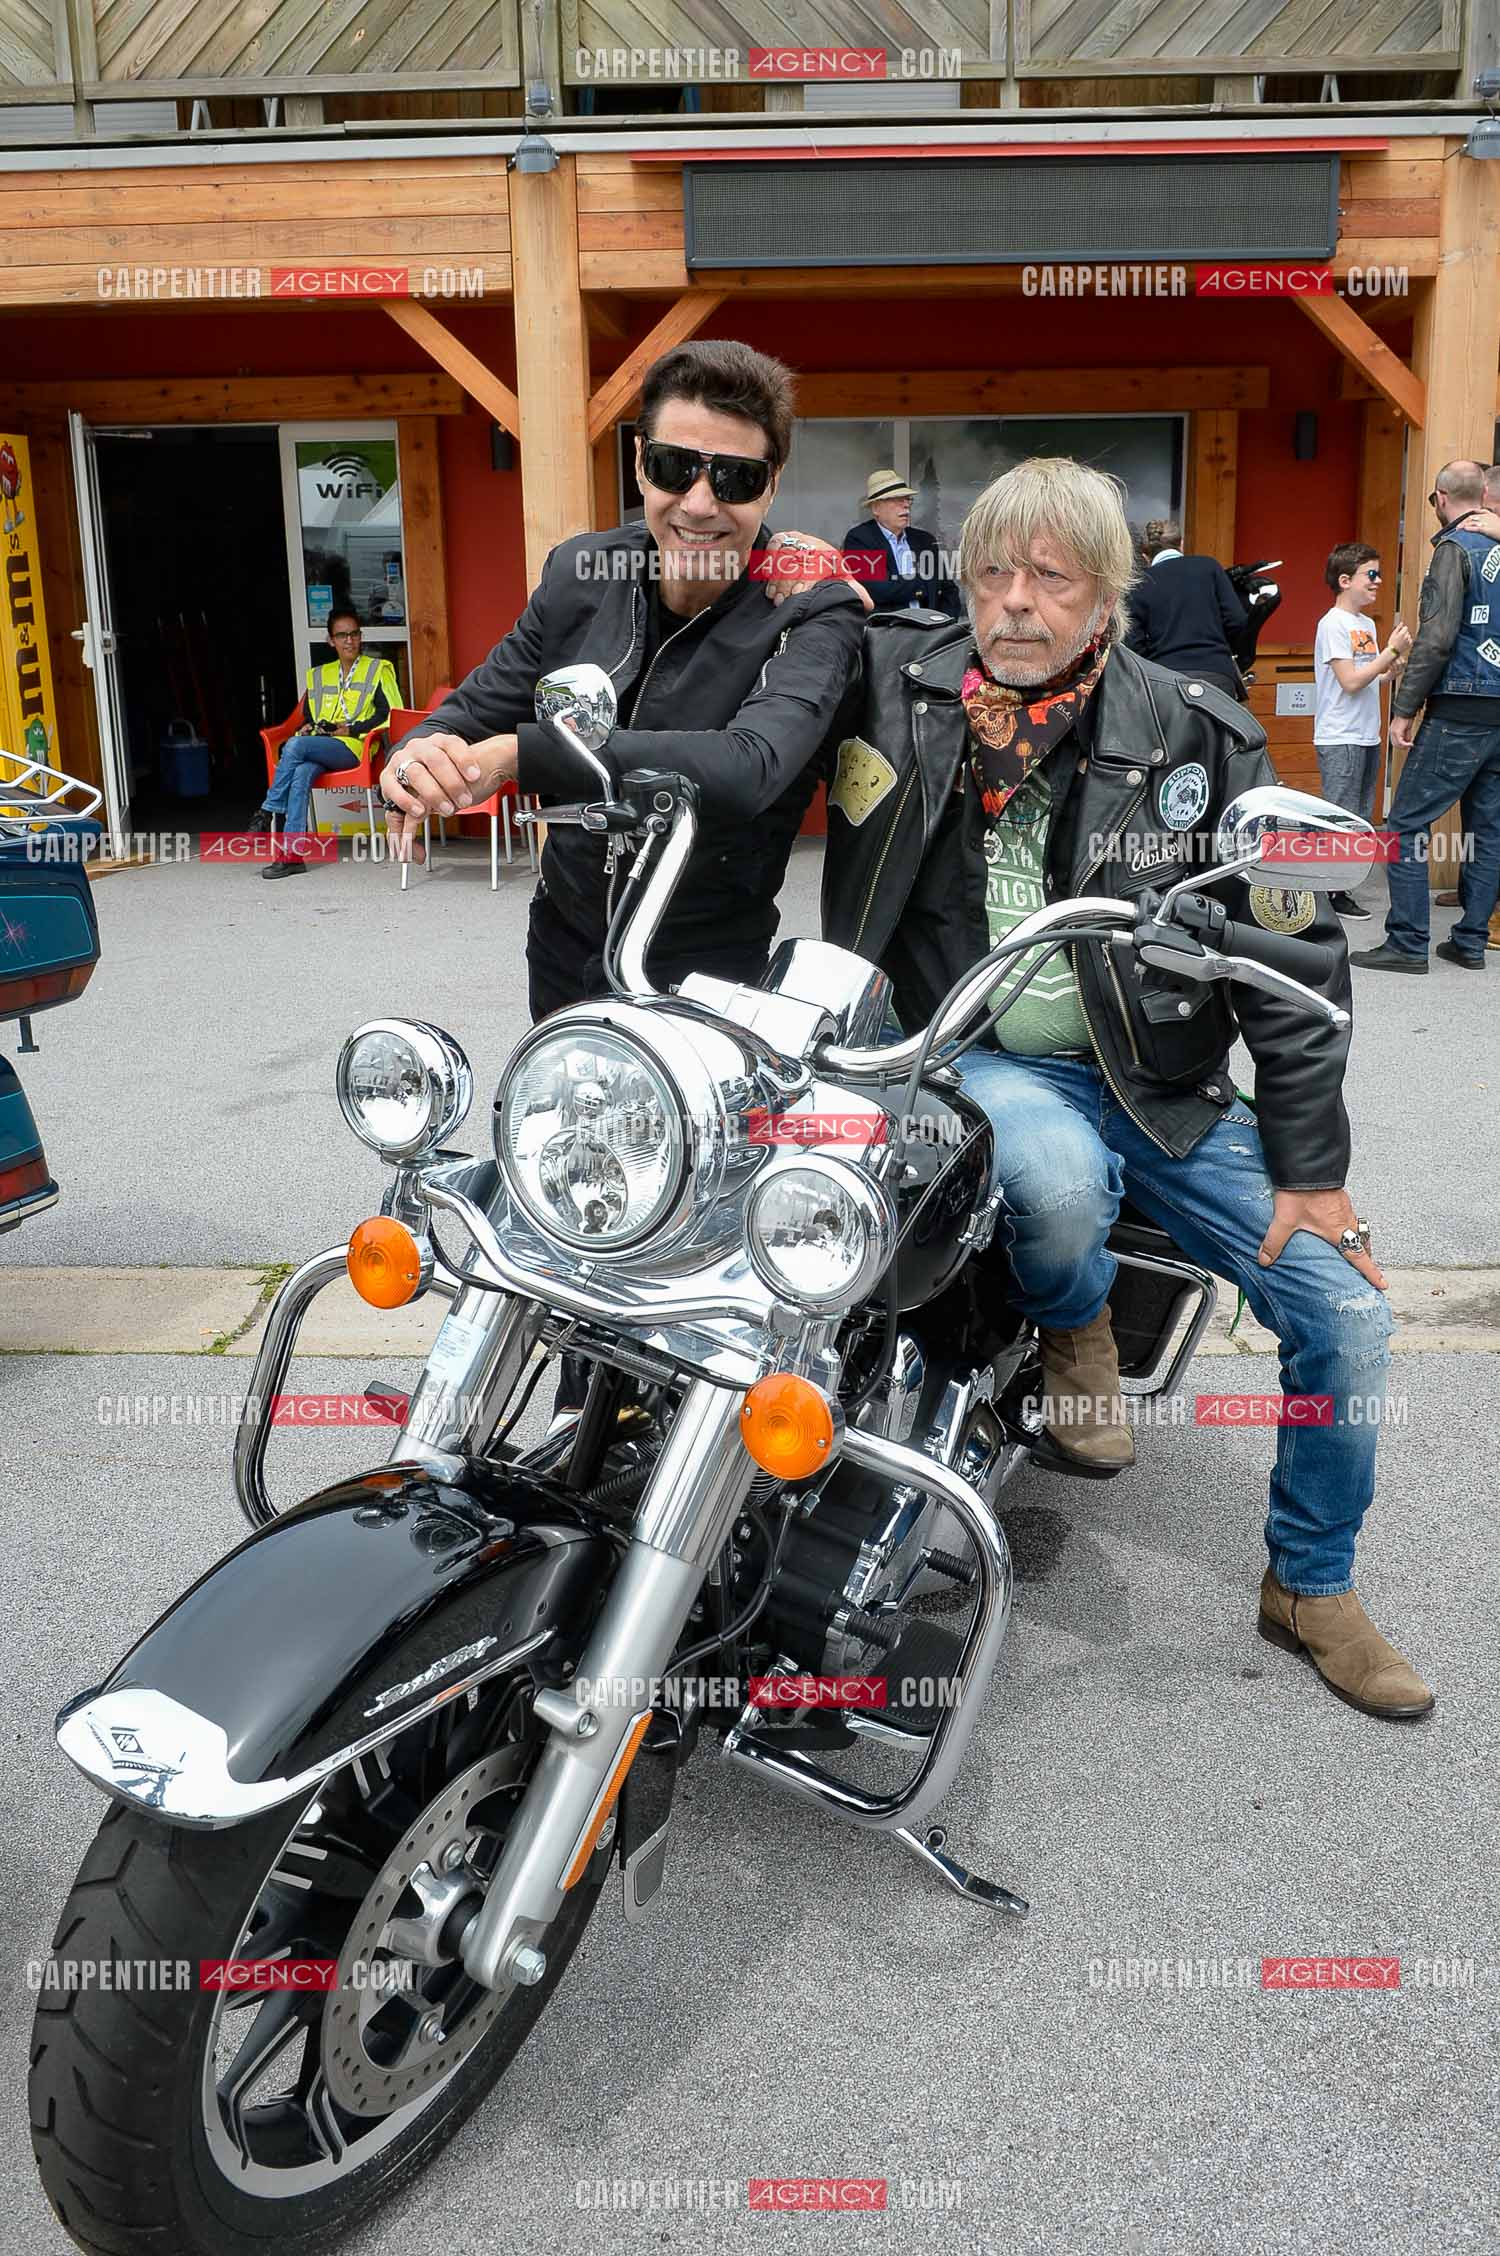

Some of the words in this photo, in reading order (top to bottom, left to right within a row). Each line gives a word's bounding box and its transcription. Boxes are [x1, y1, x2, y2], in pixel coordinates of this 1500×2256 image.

[316, 482, 383, 499] WiFi
[1473, 606, 1487, 621] 176
[1482, 643, 1500, 663] ES
